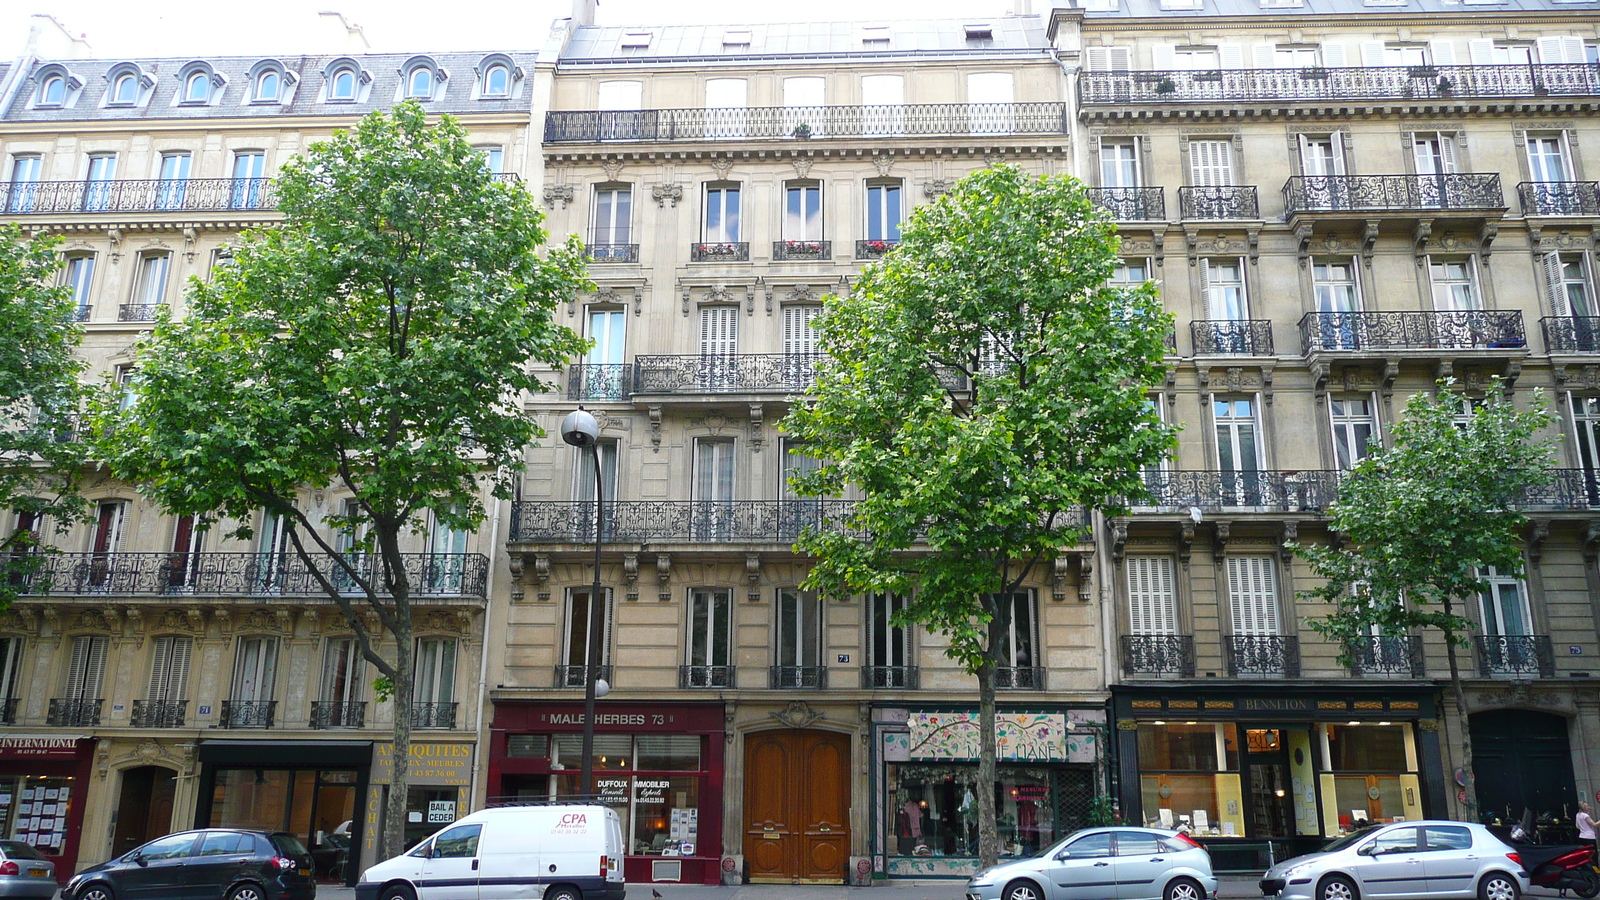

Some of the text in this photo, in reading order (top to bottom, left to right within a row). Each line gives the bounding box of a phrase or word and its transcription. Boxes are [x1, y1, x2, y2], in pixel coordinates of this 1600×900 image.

[1571, 646, 1581, 654] 75
[550, 713, 664, 725] MALEHERBES 73
[376, 744, 470, 759] ANIQUITES
[427, 760, 465, 768] MEUBLES
[597, 780, 670, 788] DUFFOUX IMMOBILIER
[640, 788, 662, 798] Experts
[430, 803, 446, 811] BAIL
[448, 803, 454, 811] A
[429, 813, 454, 822] CEDER
[562, 813, 587, 824] CPA
